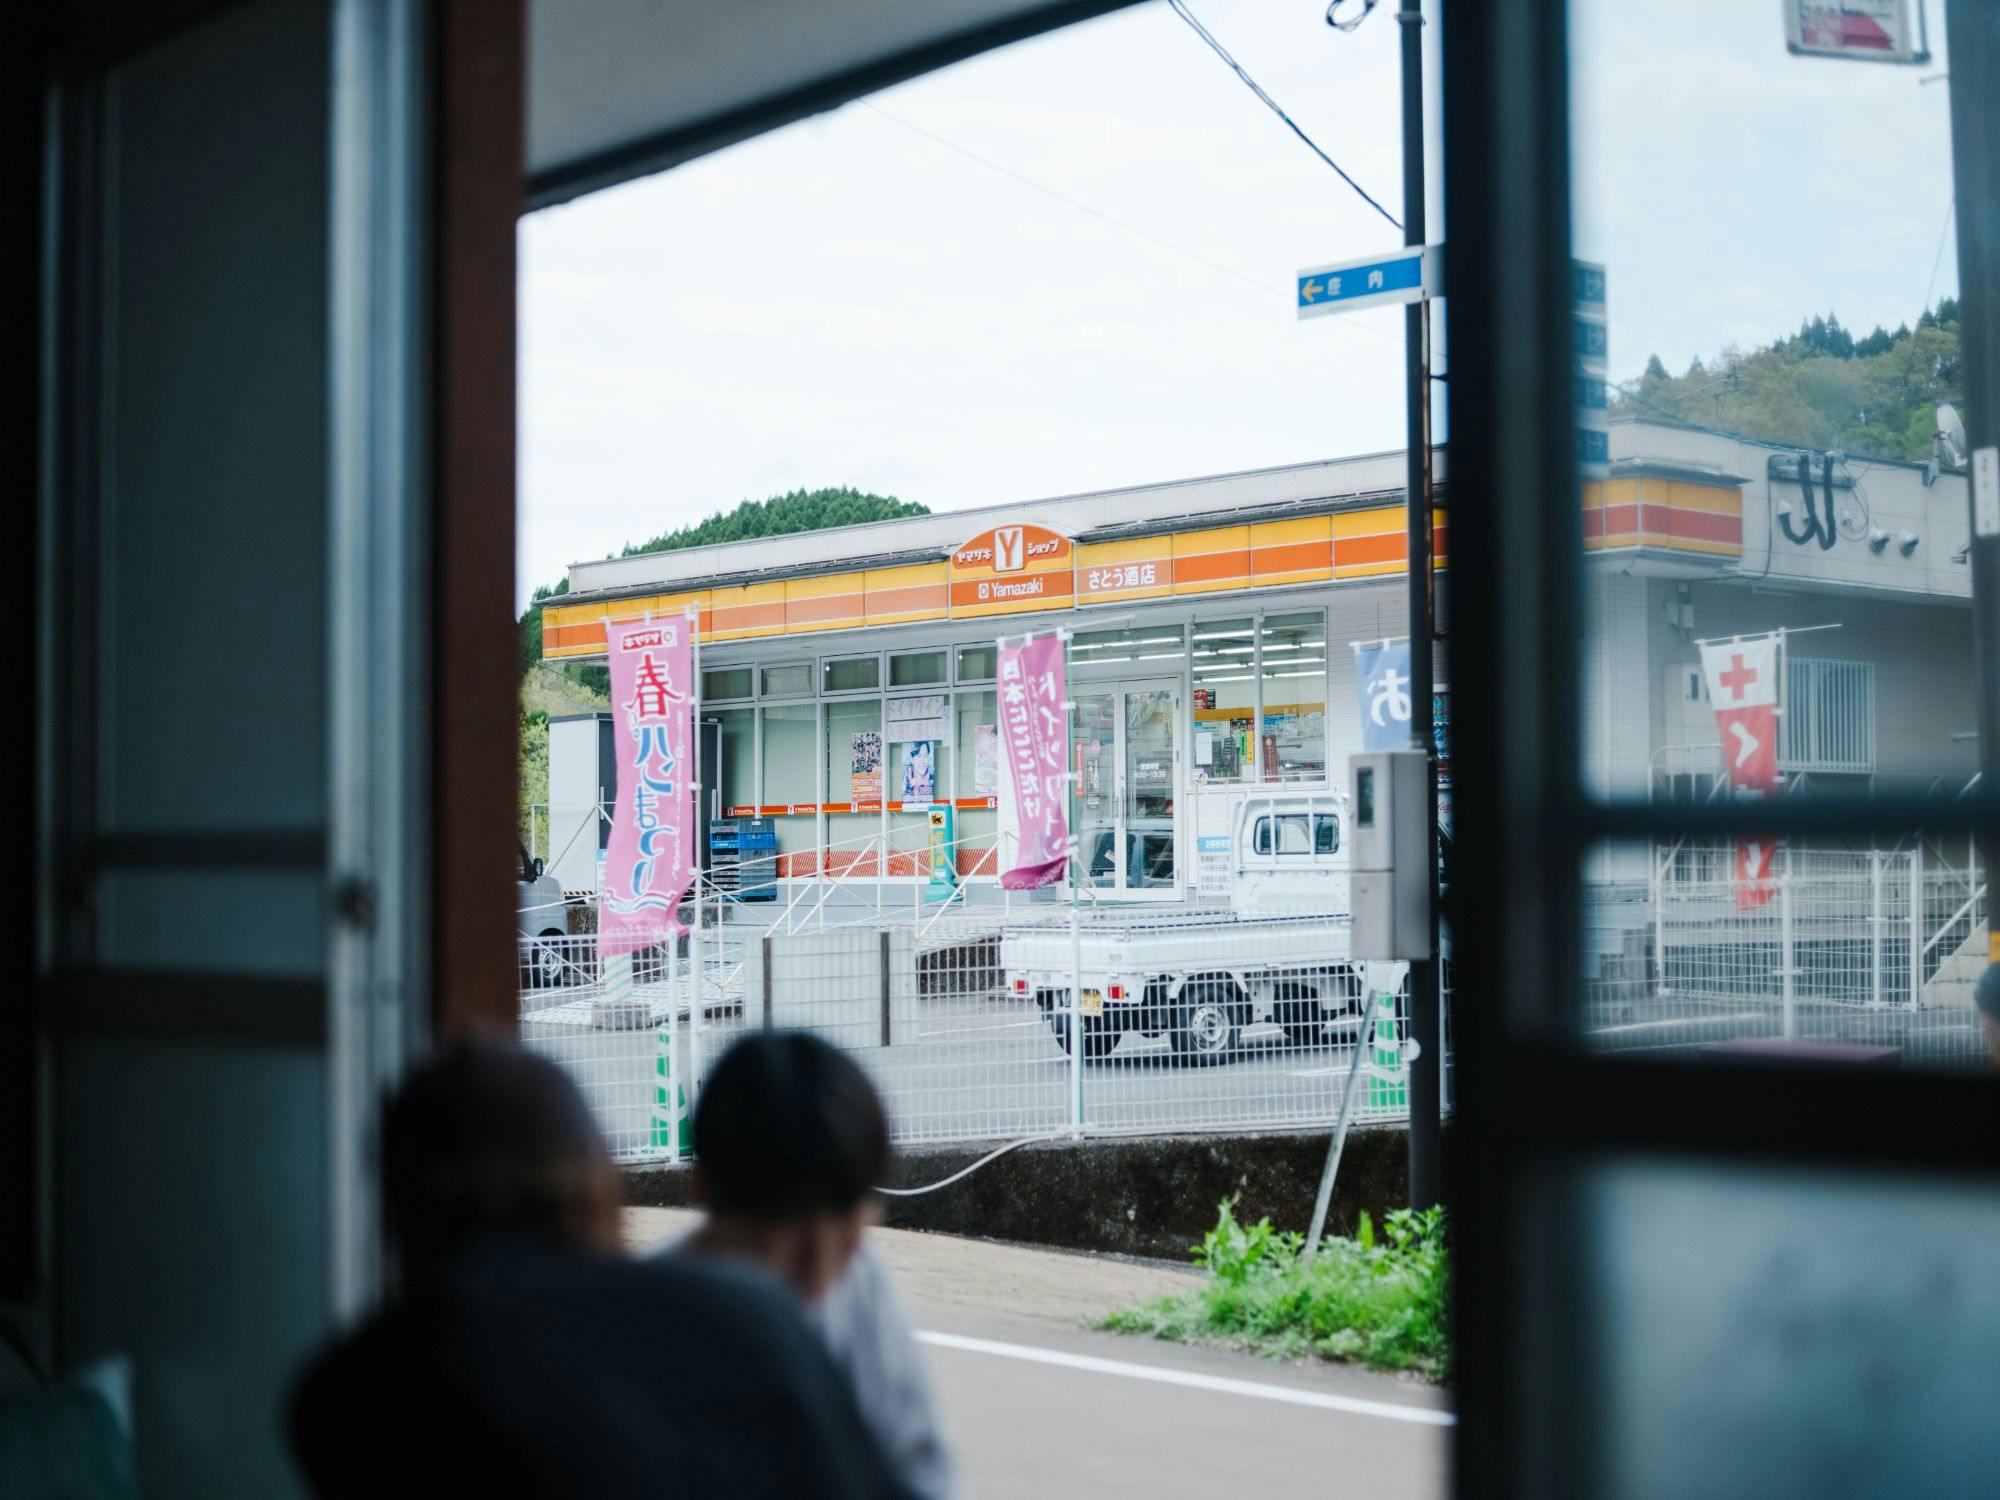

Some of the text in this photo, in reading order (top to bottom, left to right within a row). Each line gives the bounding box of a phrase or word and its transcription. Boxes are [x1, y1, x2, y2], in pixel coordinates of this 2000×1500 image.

[956, 547, 992, 564] ヤマザキ
[997, 529, 1021, 569] Y
[1027, 539, 1060, 555] ショップ
[991, 577, 1044, 599] Yamazaki
[1088, 564, 1156, 590] さとう酒店
